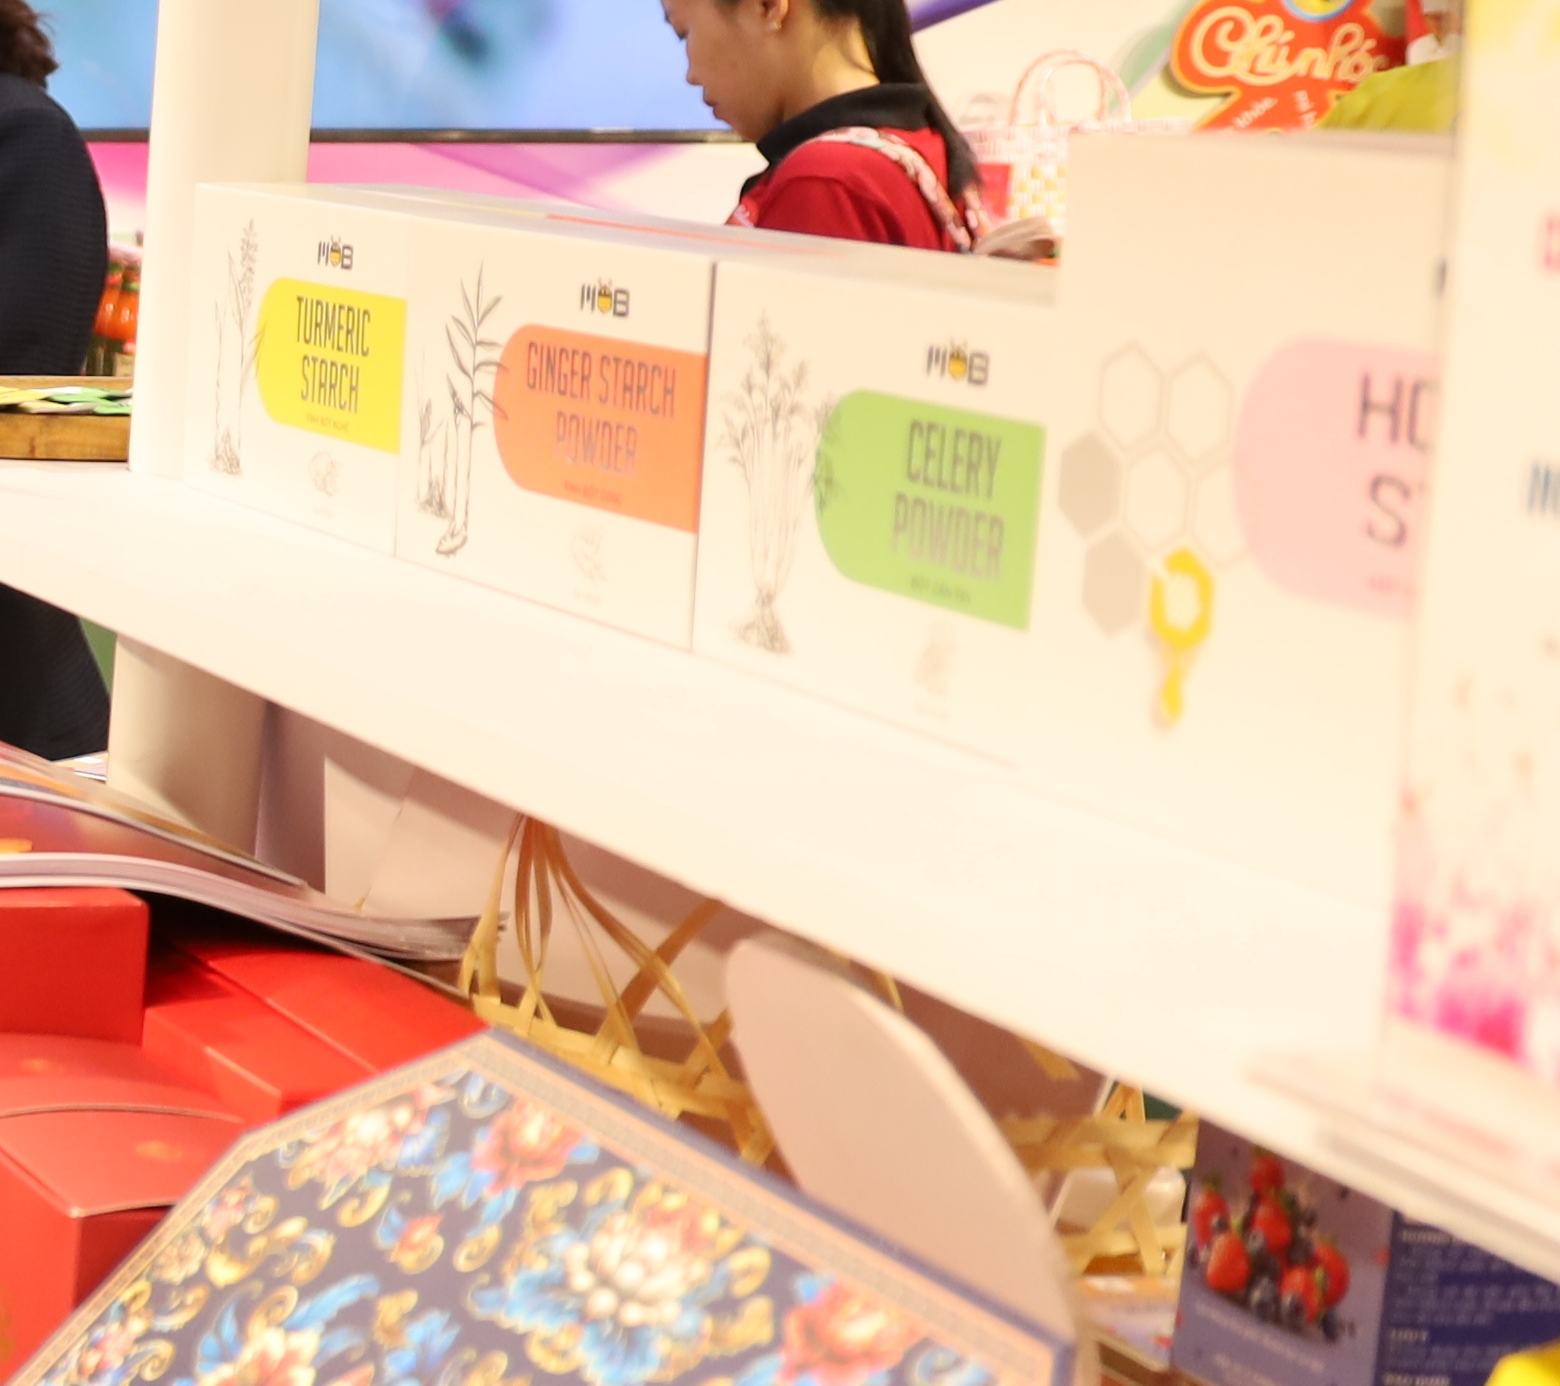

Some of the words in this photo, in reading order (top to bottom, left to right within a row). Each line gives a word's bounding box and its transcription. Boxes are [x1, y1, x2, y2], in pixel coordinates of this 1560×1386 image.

[296, 295, 371, 357] TURMERIC
[301, 355, 359, 413] STARCH
[526, 341, 591, 399] GINGER
[598, 354, 677, 417] STARCH
[555, 410, 638, 475] POWDER
[906, 419, 1001, 501] CELERY
[892, 490, 1005, 581] POWDER
